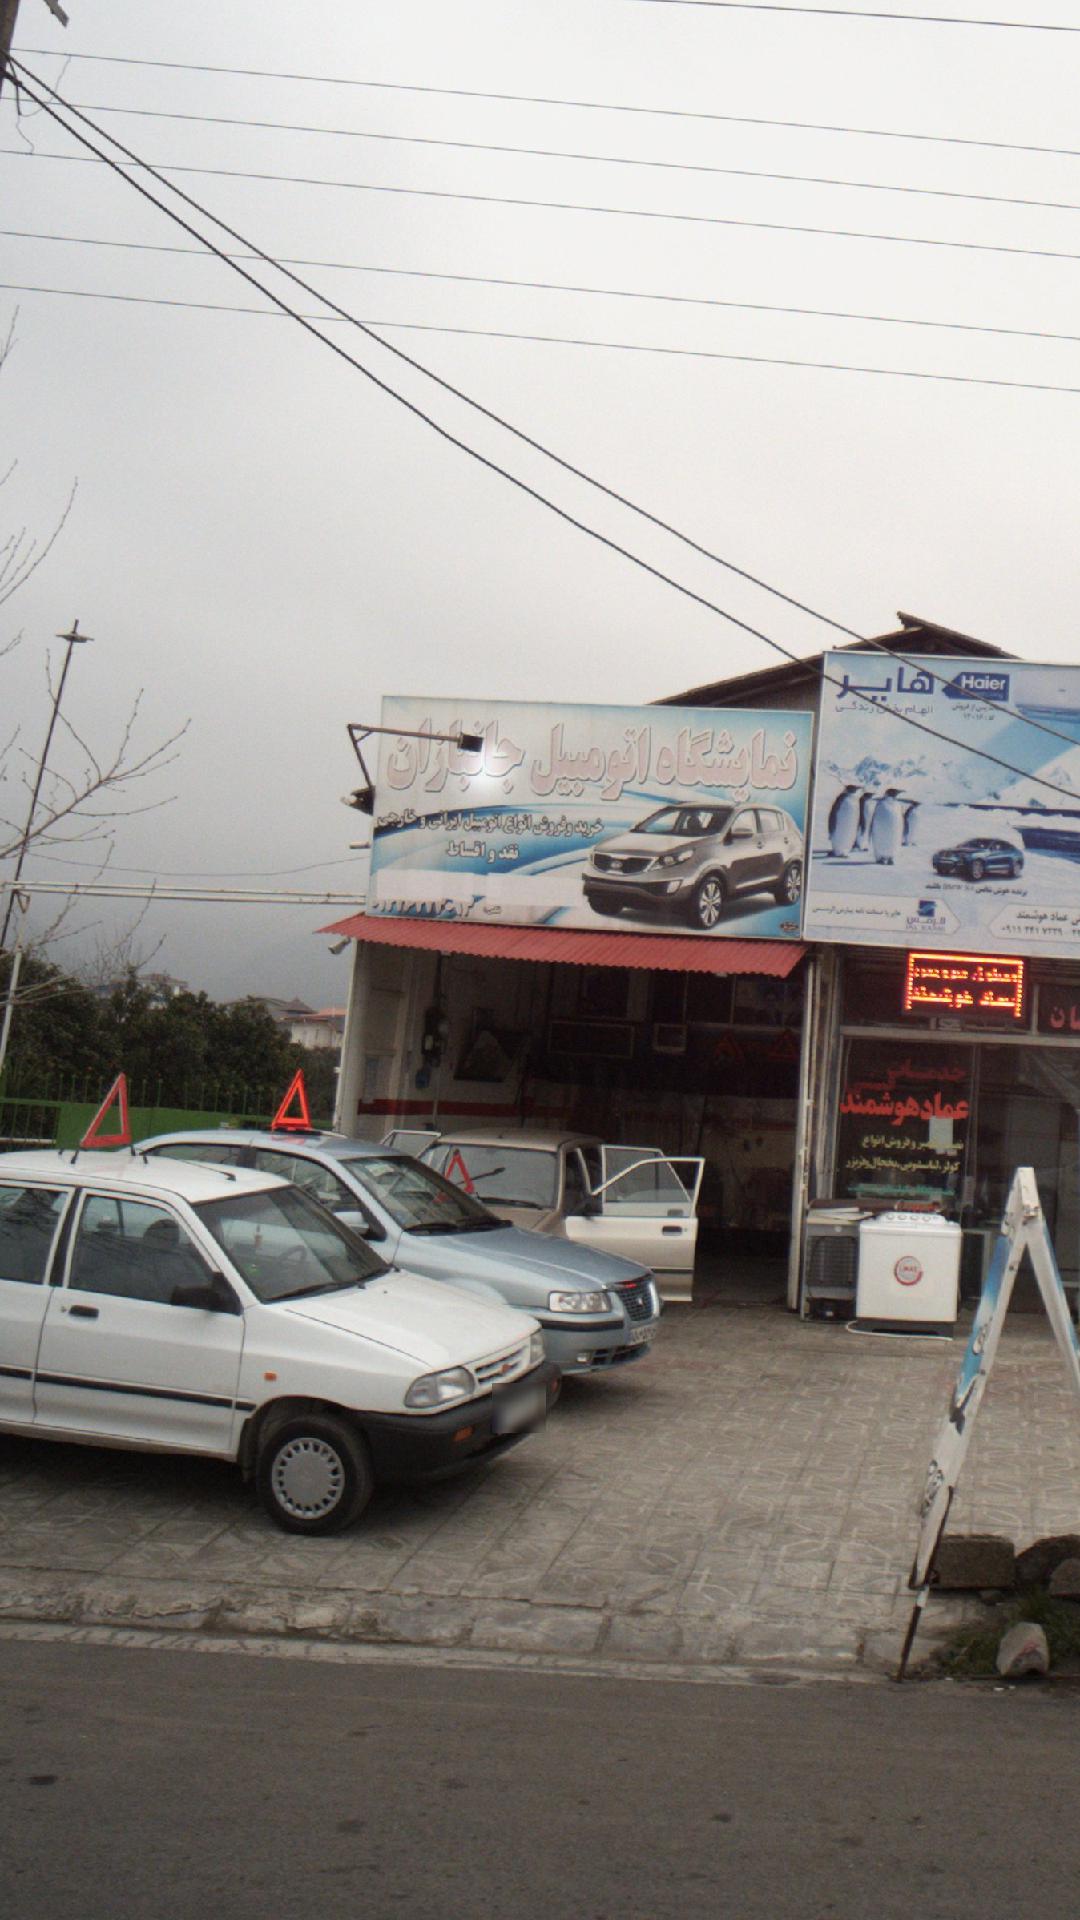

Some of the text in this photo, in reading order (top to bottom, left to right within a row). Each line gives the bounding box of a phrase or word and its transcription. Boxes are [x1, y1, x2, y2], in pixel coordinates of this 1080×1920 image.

[960, 675, 1006, 691] Haier
[387, 717, 798, 802] نمایشگاه اتومبیل جانبازان
[503, 813, 532, 834] انواع
[574, 817, 604, 838] خرید
[447, 840, 520, 864] نقد و اقساط
